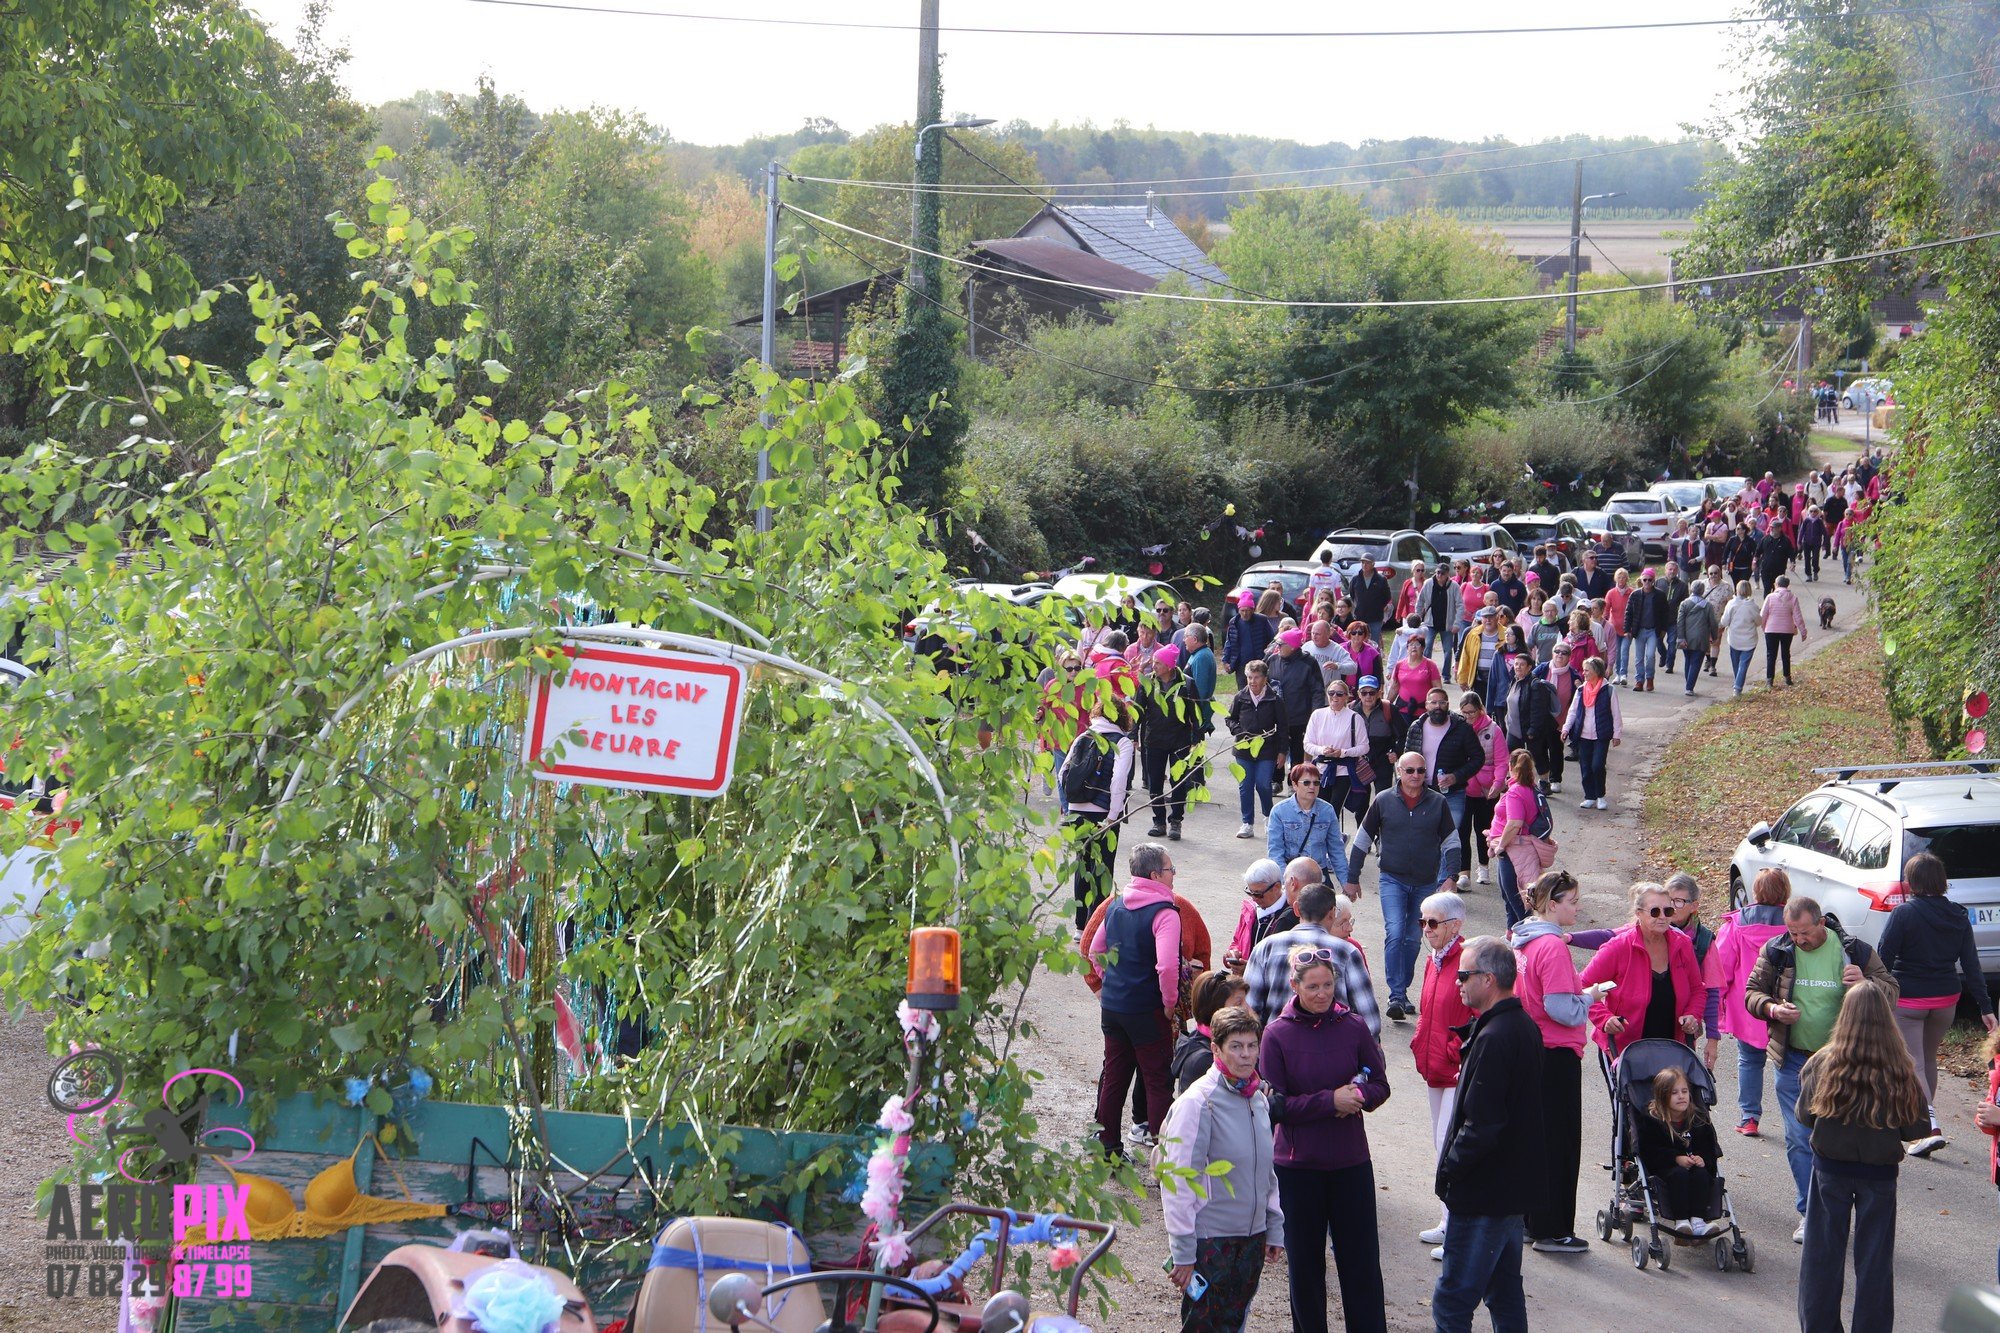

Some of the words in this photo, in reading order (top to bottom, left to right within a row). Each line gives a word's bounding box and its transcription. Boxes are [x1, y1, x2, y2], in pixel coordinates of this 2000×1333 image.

[569, 668, 707, 704] MONTAGNY
[611, 704, 657, 727] LES
[1810, 980, 1838, 988] ESPOIR
